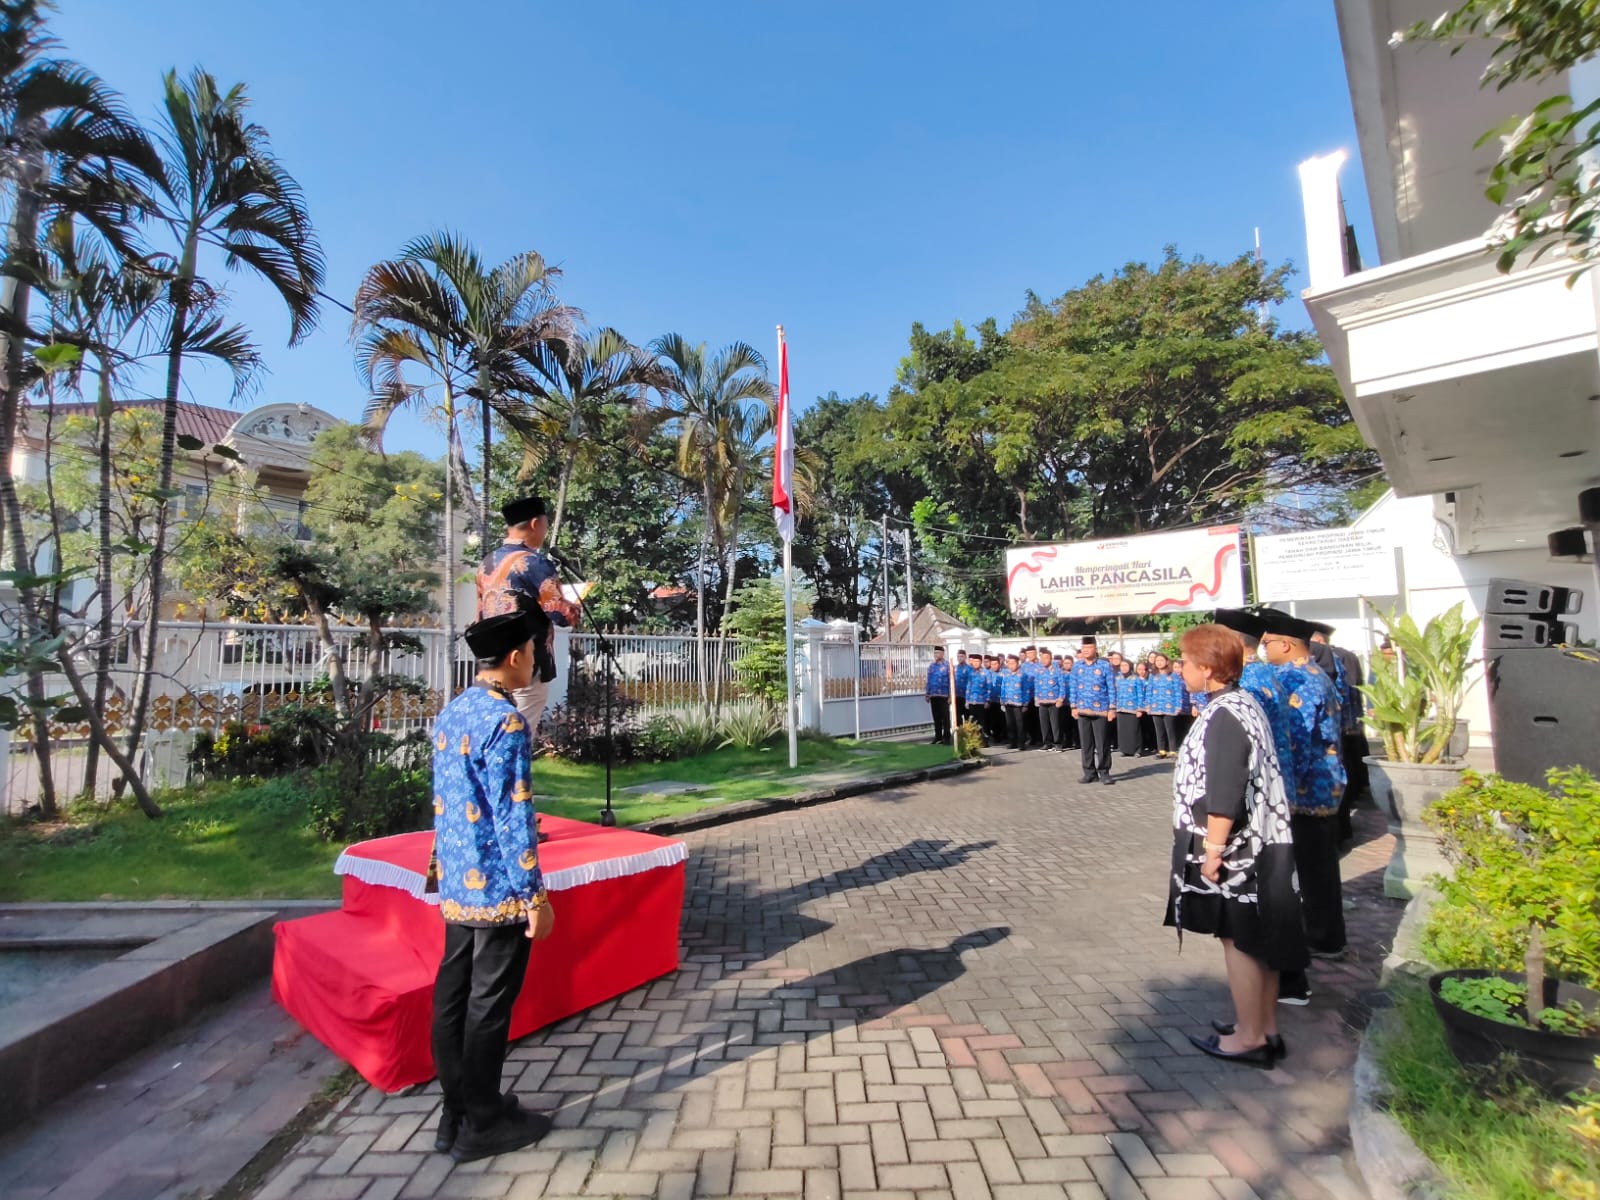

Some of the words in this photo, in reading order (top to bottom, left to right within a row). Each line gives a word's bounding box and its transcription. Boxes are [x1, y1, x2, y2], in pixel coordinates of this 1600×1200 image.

[1075, 561, 1129, 575] Memperingati
[1131, 560, 1152, 569] Hari
[1040, 575, 1085, 590] LAHIR
[1091, 566, 1192, 586] PANCASILA
